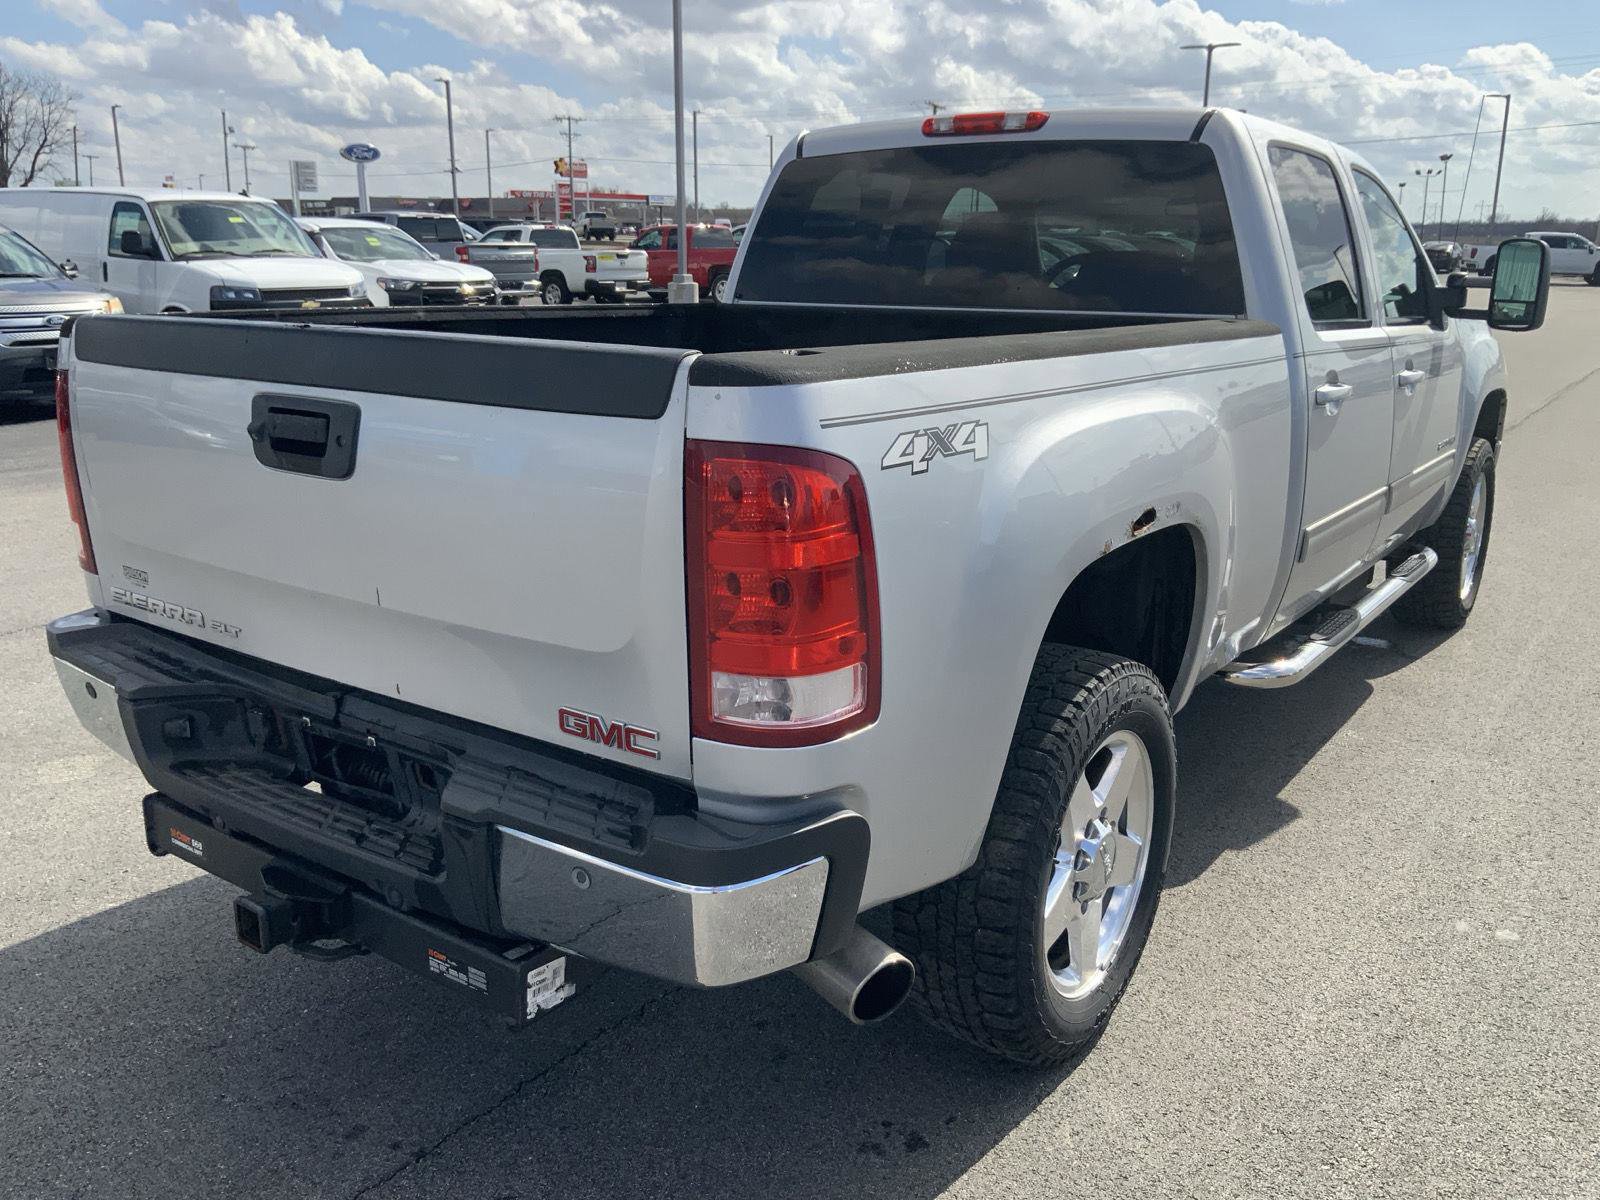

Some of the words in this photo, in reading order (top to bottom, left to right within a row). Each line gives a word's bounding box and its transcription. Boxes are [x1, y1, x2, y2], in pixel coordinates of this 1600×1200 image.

[350, 147, 375, 158] Ford
[110, 586, 206, 629] SIERRA
[209, 619, 242, 638] SLT
[558, 706, 661, 760] GMC
